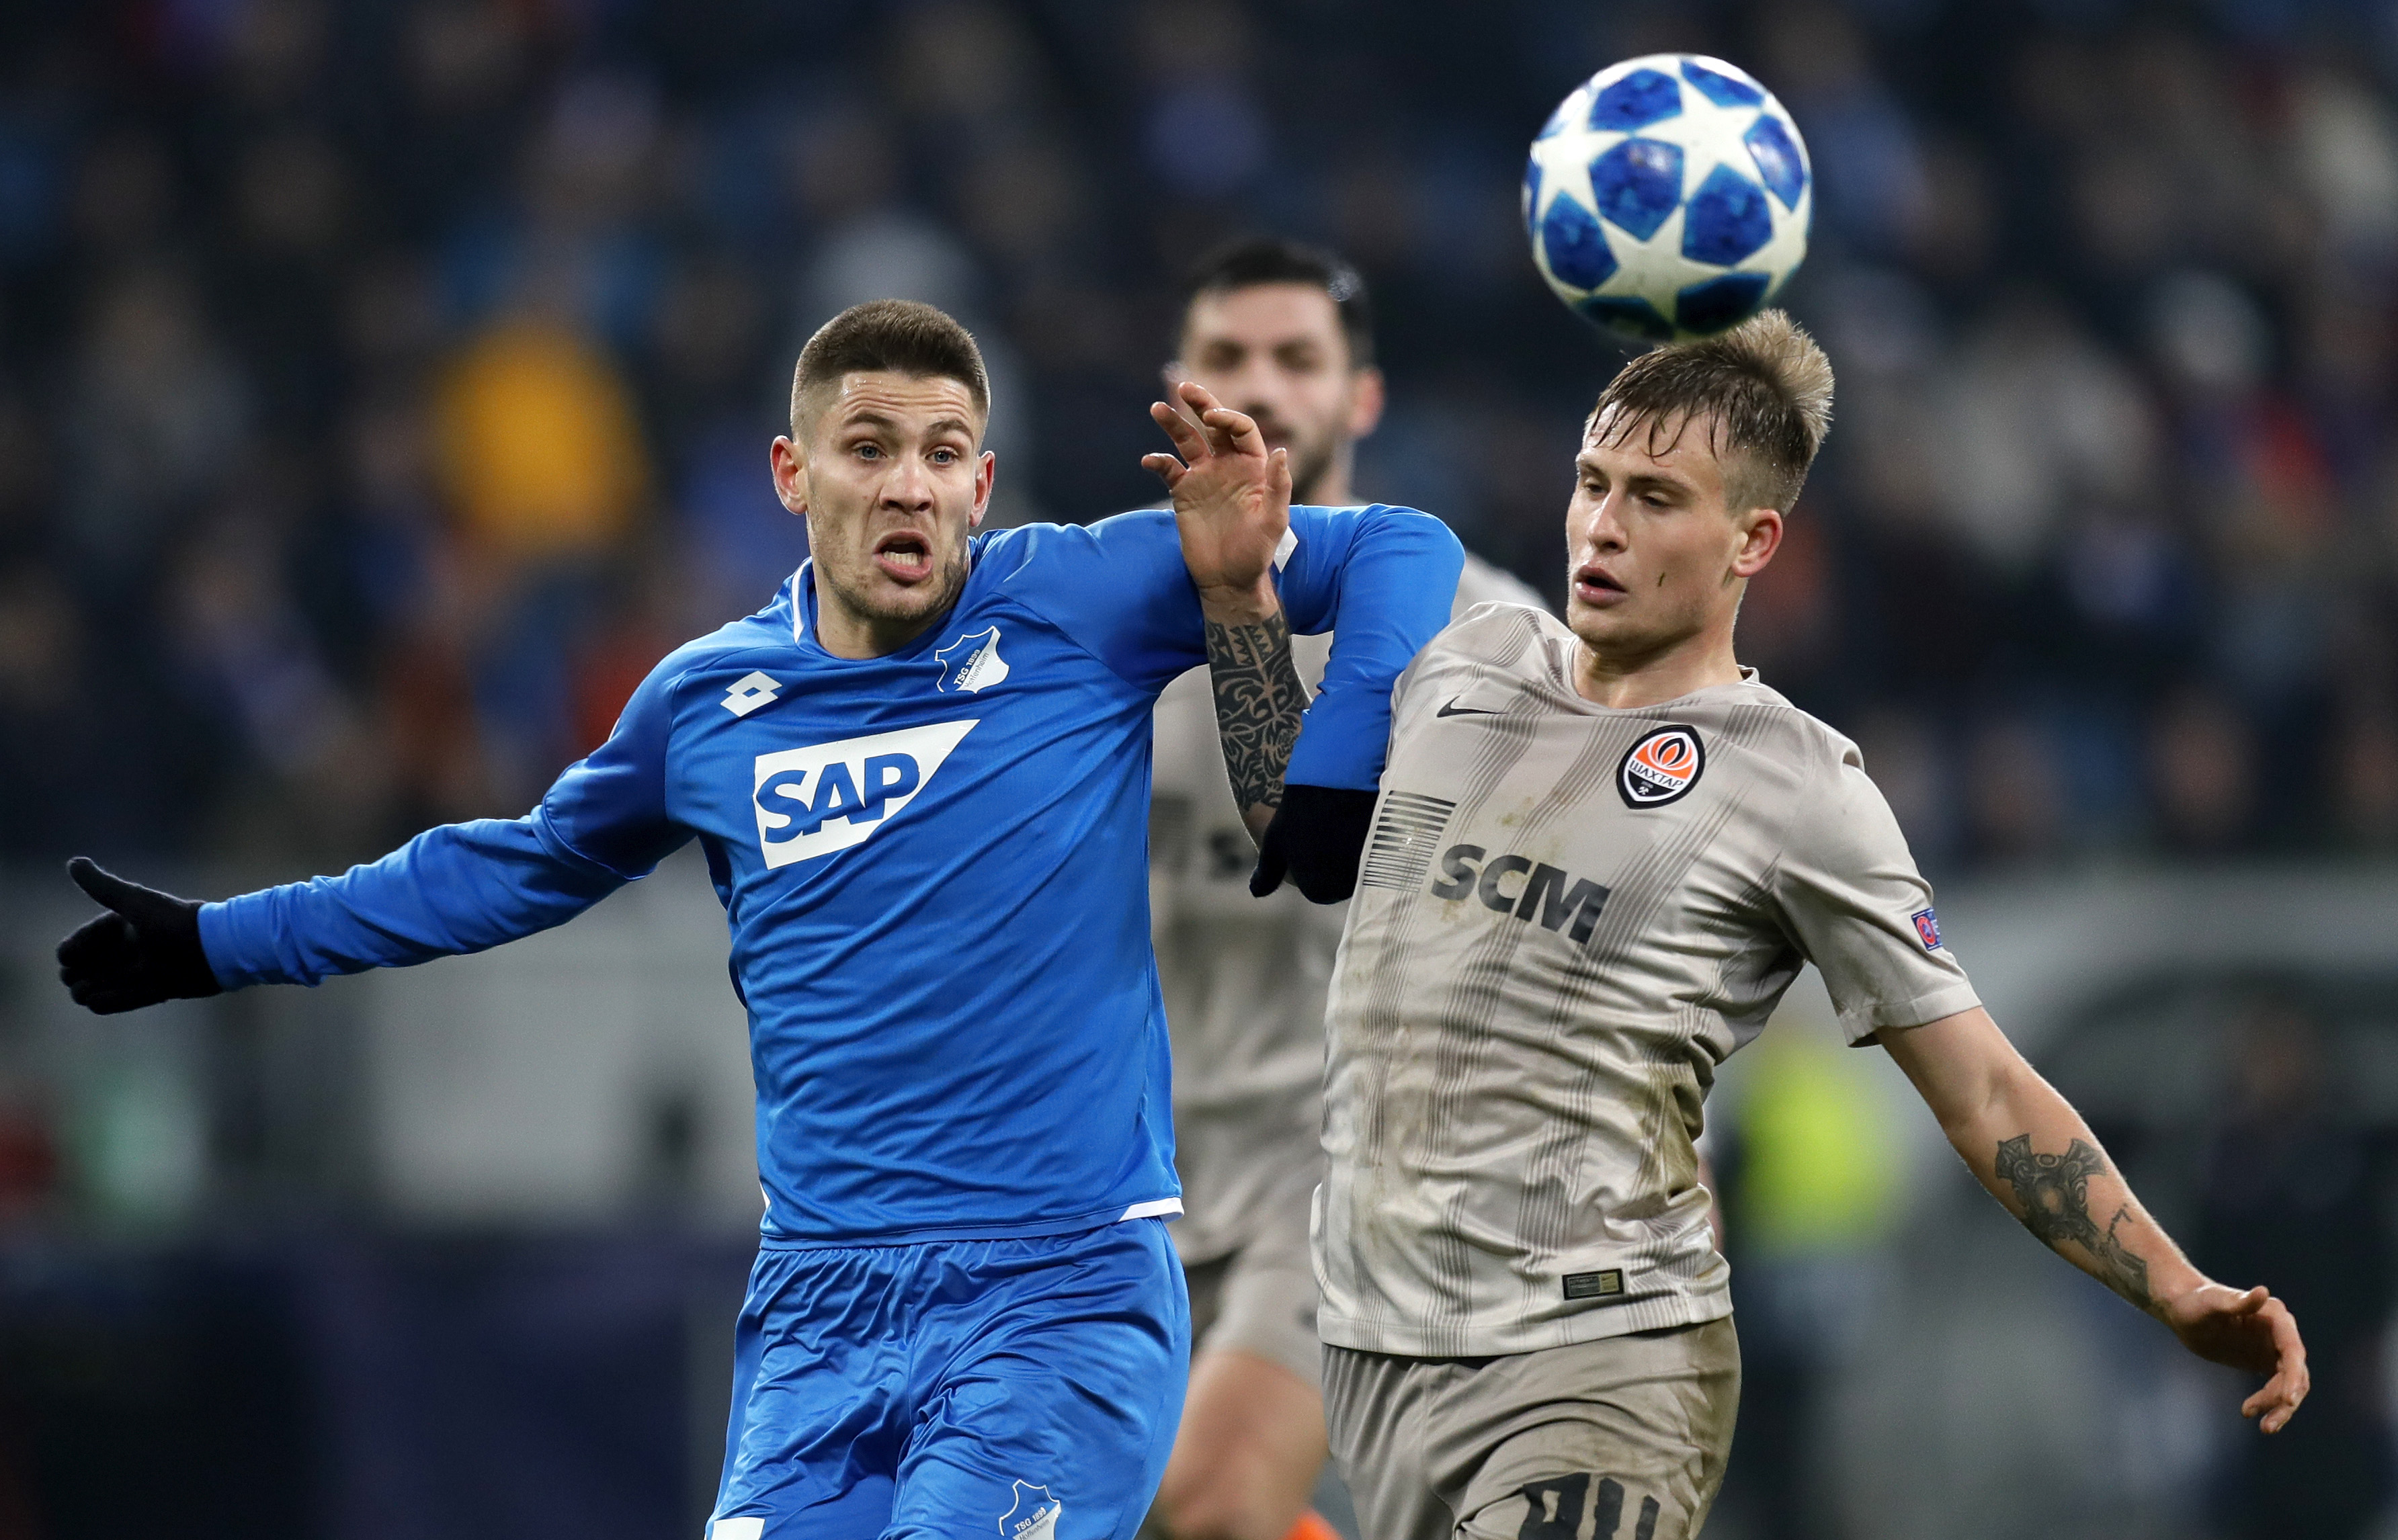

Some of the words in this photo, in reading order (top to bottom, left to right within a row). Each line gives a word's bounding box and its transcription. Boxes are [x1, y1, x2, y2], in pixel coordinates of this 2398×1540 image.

[953, 667, 969, 685] TSG
[966, 649, 981, 667] 1899
[1629, 760, 1684, 787] ШАХТАР
[755, 753, 921, 844] SAP
[1431, 843, 1613, 945] SCM
[1014, 1518, 1032, 1533] TSG
